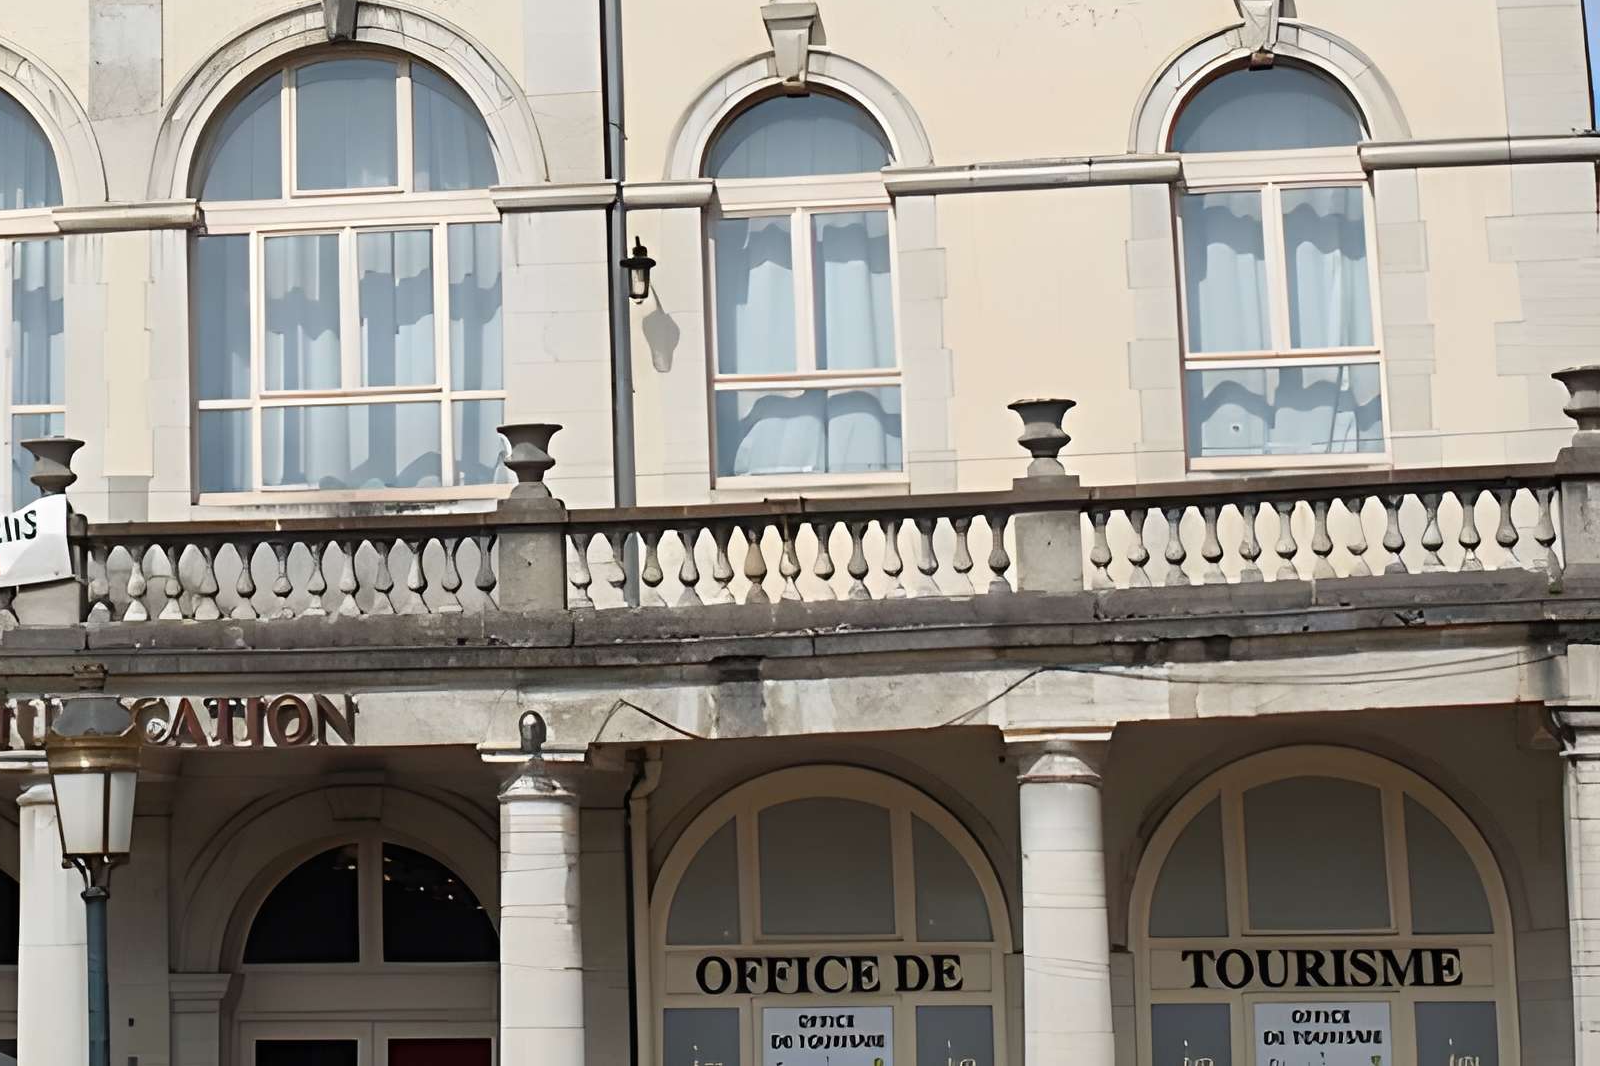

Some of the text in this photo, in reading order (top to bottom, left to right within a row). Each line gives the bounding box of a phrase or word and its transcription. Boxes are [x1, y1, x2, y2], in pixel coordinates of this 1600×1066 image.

[696, 954, 964, 995] OFFICE DE
[1181, 948, 1464, 989] TOURISME
